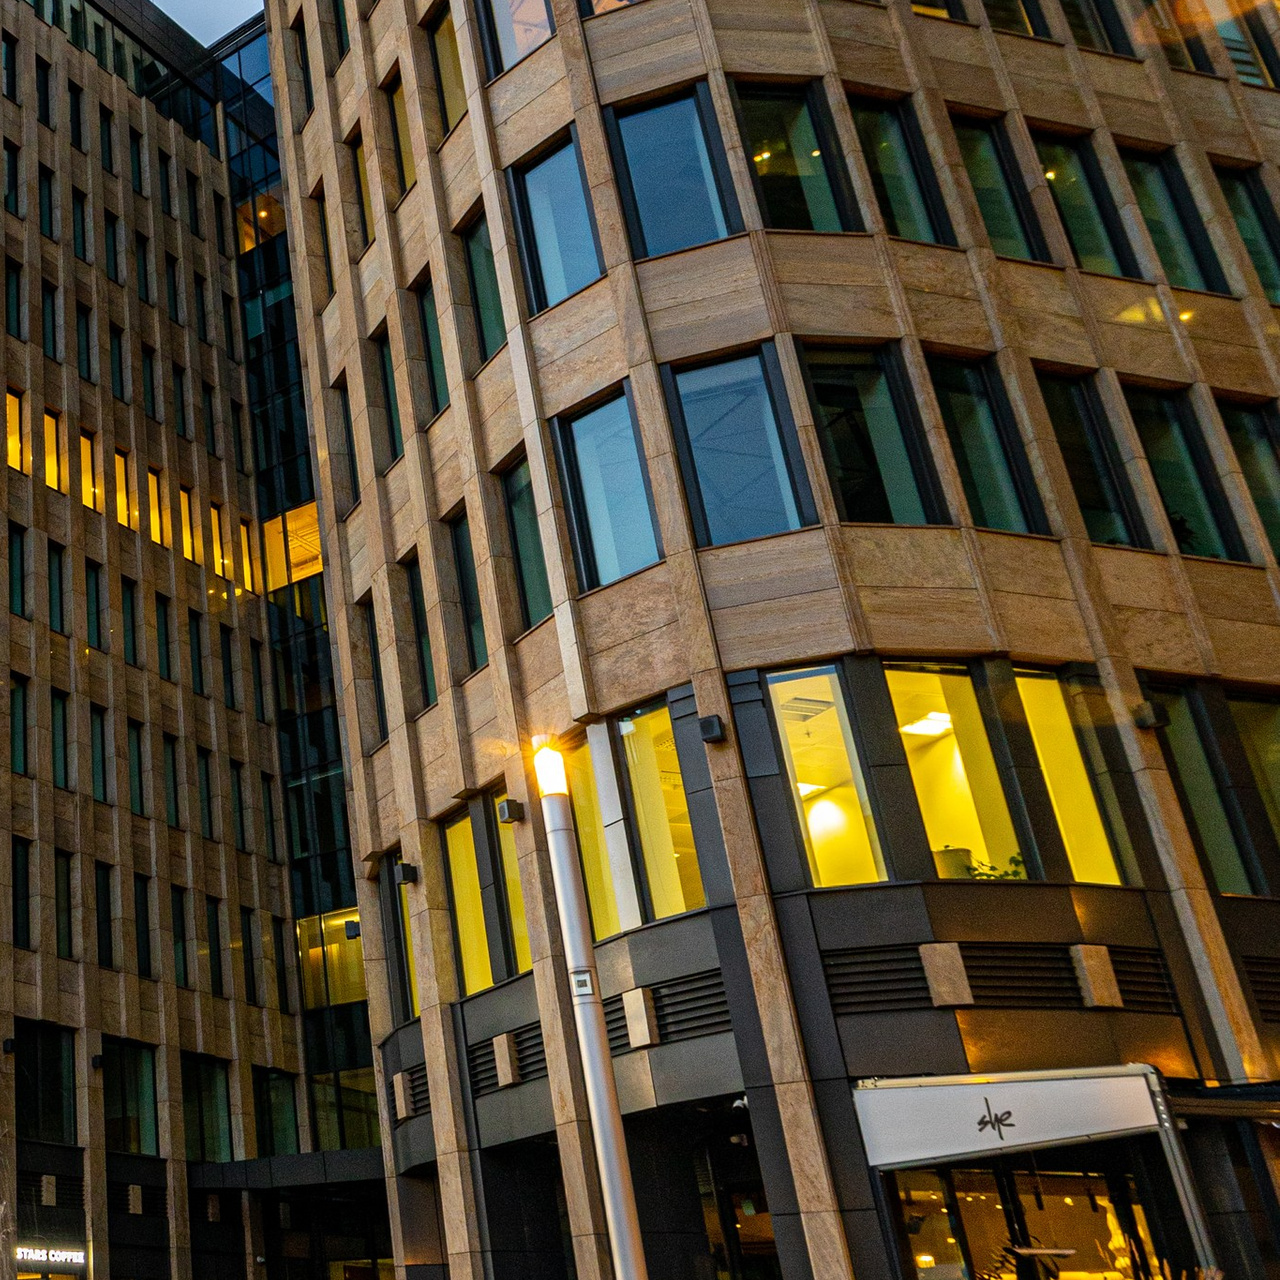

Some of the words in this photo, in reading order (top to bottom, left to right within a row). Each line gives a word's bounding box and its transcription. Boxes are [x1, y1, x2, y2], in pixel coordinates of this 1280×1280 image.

[977, 1096, 1016, 1141] she
[16, 1248, 47, 1261] STARS
[49, 1250, 85, 1263] COFFEE
